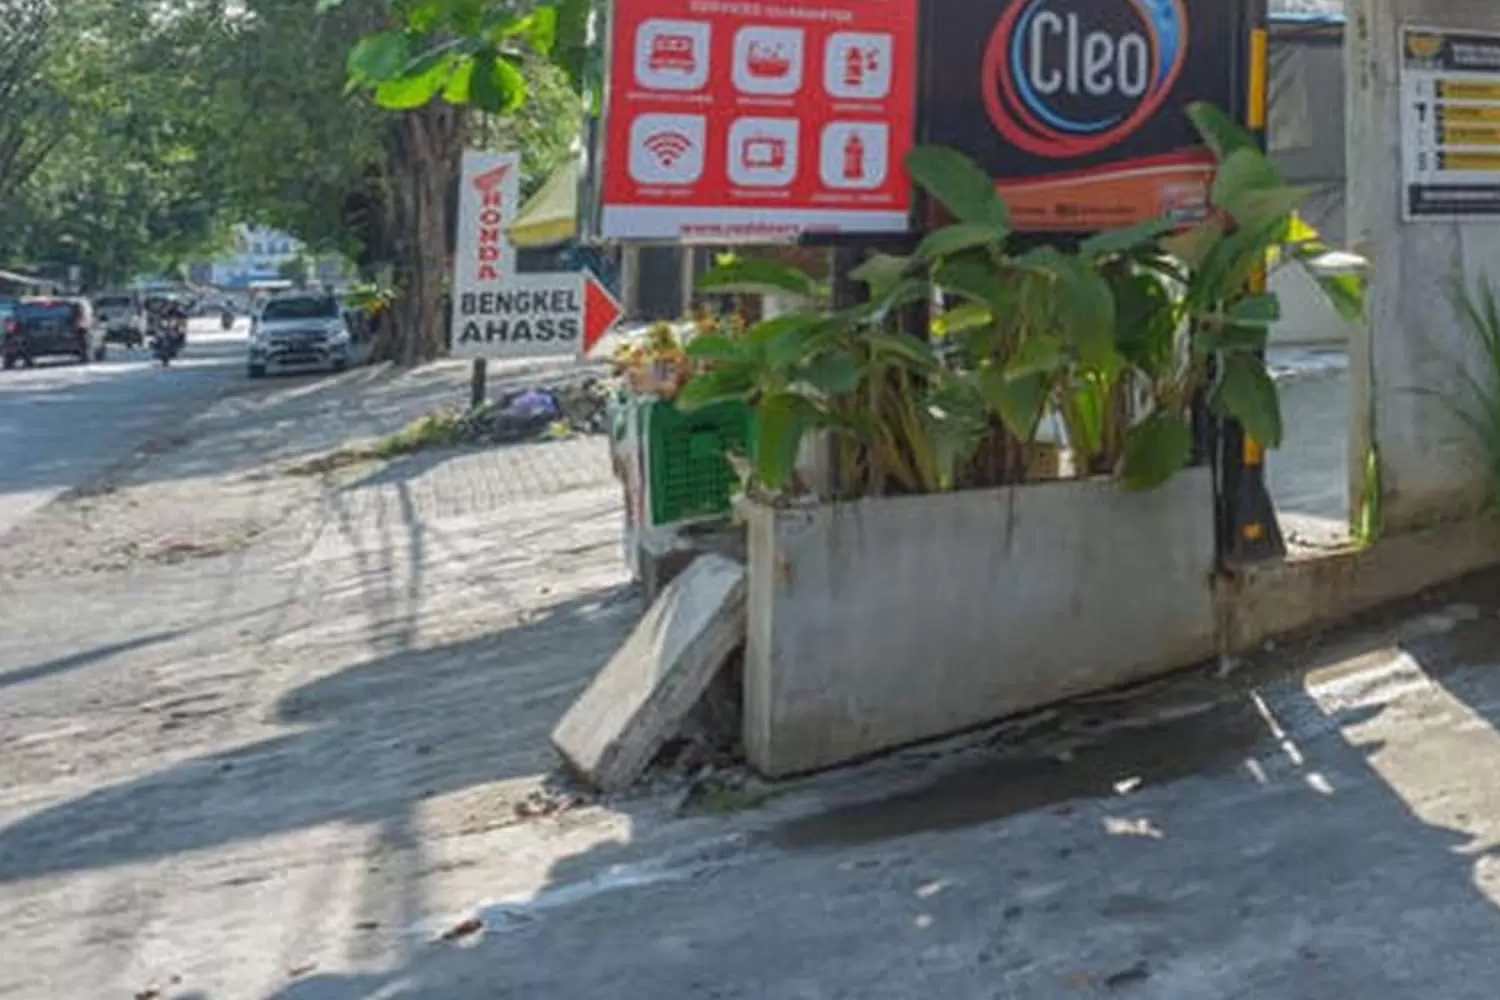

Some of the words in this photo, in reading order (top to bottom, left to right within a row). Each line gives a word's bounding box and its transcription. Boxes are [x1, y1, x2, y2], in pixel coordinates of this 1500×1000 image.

[1029, 10, 1149, 97] Cleo
[477, 190, 503, 281] HONDA
[460, 289, 581, 315] BENGKEL
[458, 319, 579, 344] AHASS
